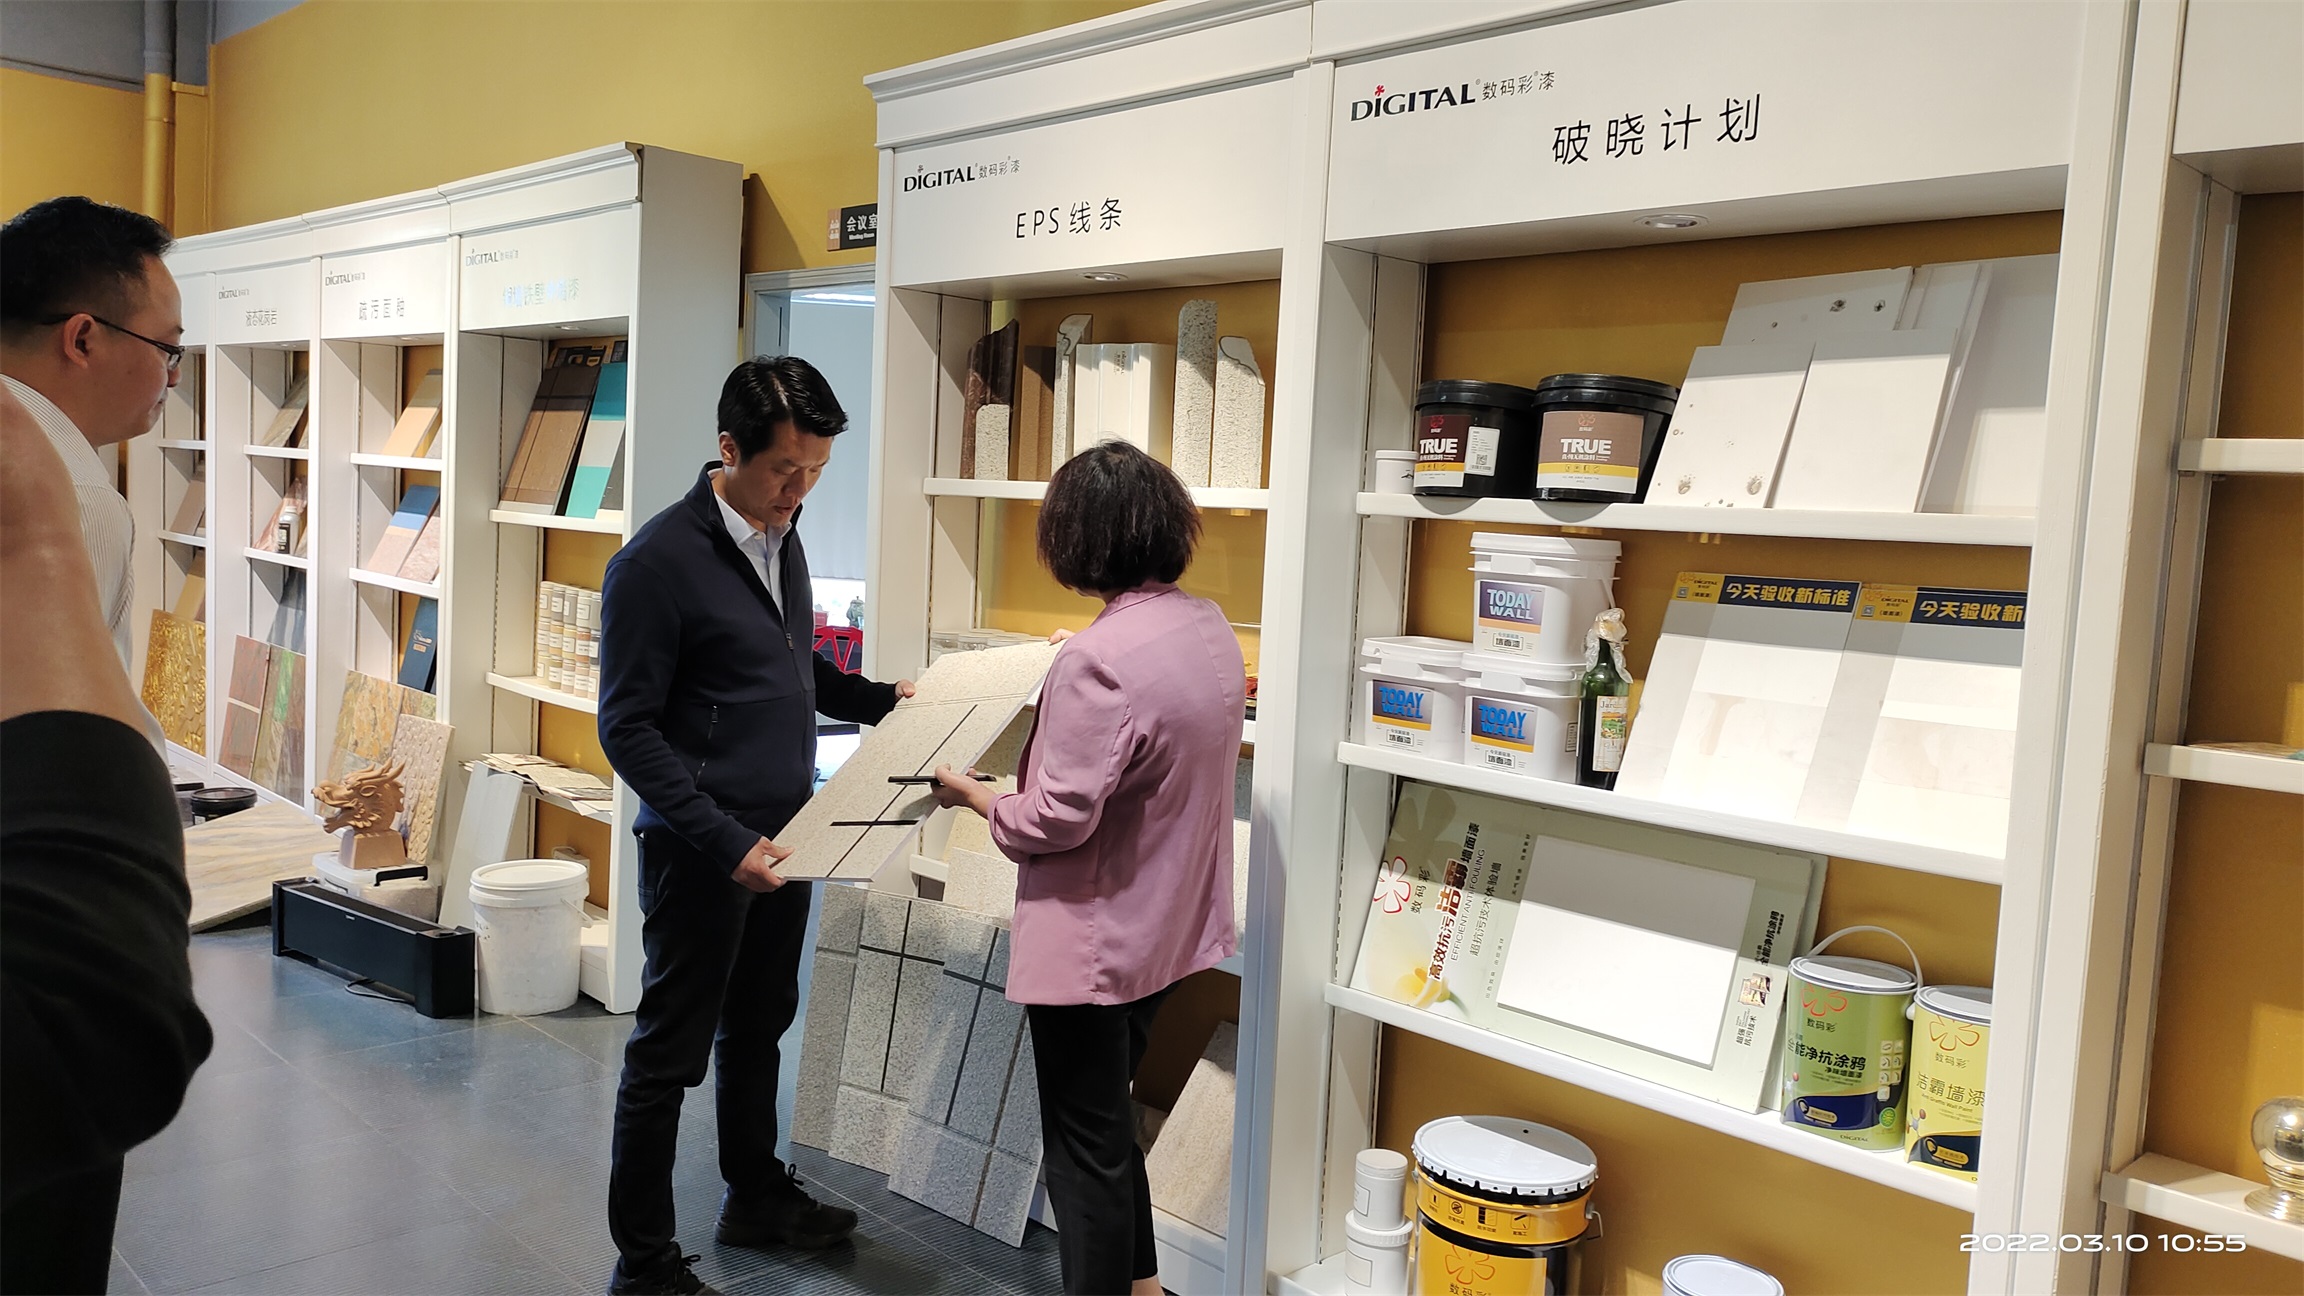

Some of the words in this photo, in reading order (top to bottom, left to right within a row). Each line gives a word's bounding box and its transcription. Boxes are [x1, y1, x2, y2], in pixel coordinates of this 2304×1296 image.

[1481, 71, 1556, 101] 数码彩漆
[1350, 84, 1476, 122] DIGITAL
[1551, 93, 1762, 167] 破晓计划
[903, 164, 976, 193] DIGITAL
[846, 213, 878, 232] 会议室
[1015, 206, 1060, 239] EPS
[1068, 197, 1123, 235] 线条
[464, 248, 499, 267] DIGITAL
[1420, 438, 1459, 454] TRUE
[1560, 438, 1613, 455] TRUE
[1486, 588, 1535, 610] TODAY
[1725, 582, 1852, 608] 今天验收新标准
[1489, 605, 1534, 621] WALL
[1919, 600, 2025, 623] 今天验收新
[1379, 686, 1424, 709] TODAY
[1381, 703, 1423, 719] WALL
[1478, 704, 1527, 730] TODAY
[1481, 721, 1526, 740] WALL
[1468, 849, 1486, 891] FOULING
[1410, 868, 1431, 914] 数码彩
[1464, 891, 1475, 912] ANTI
[1469, 862, 1502, 957] 超抗污技术体验墙
[1450, 914, 1470, 961] EFFICIENT
[1806, 1018, 1837, 1033] 数码彩
[1935, 1052, 1968, 1069] 数码彩
[1916, 1072, 1986, 1108] 洁霸墙漆
